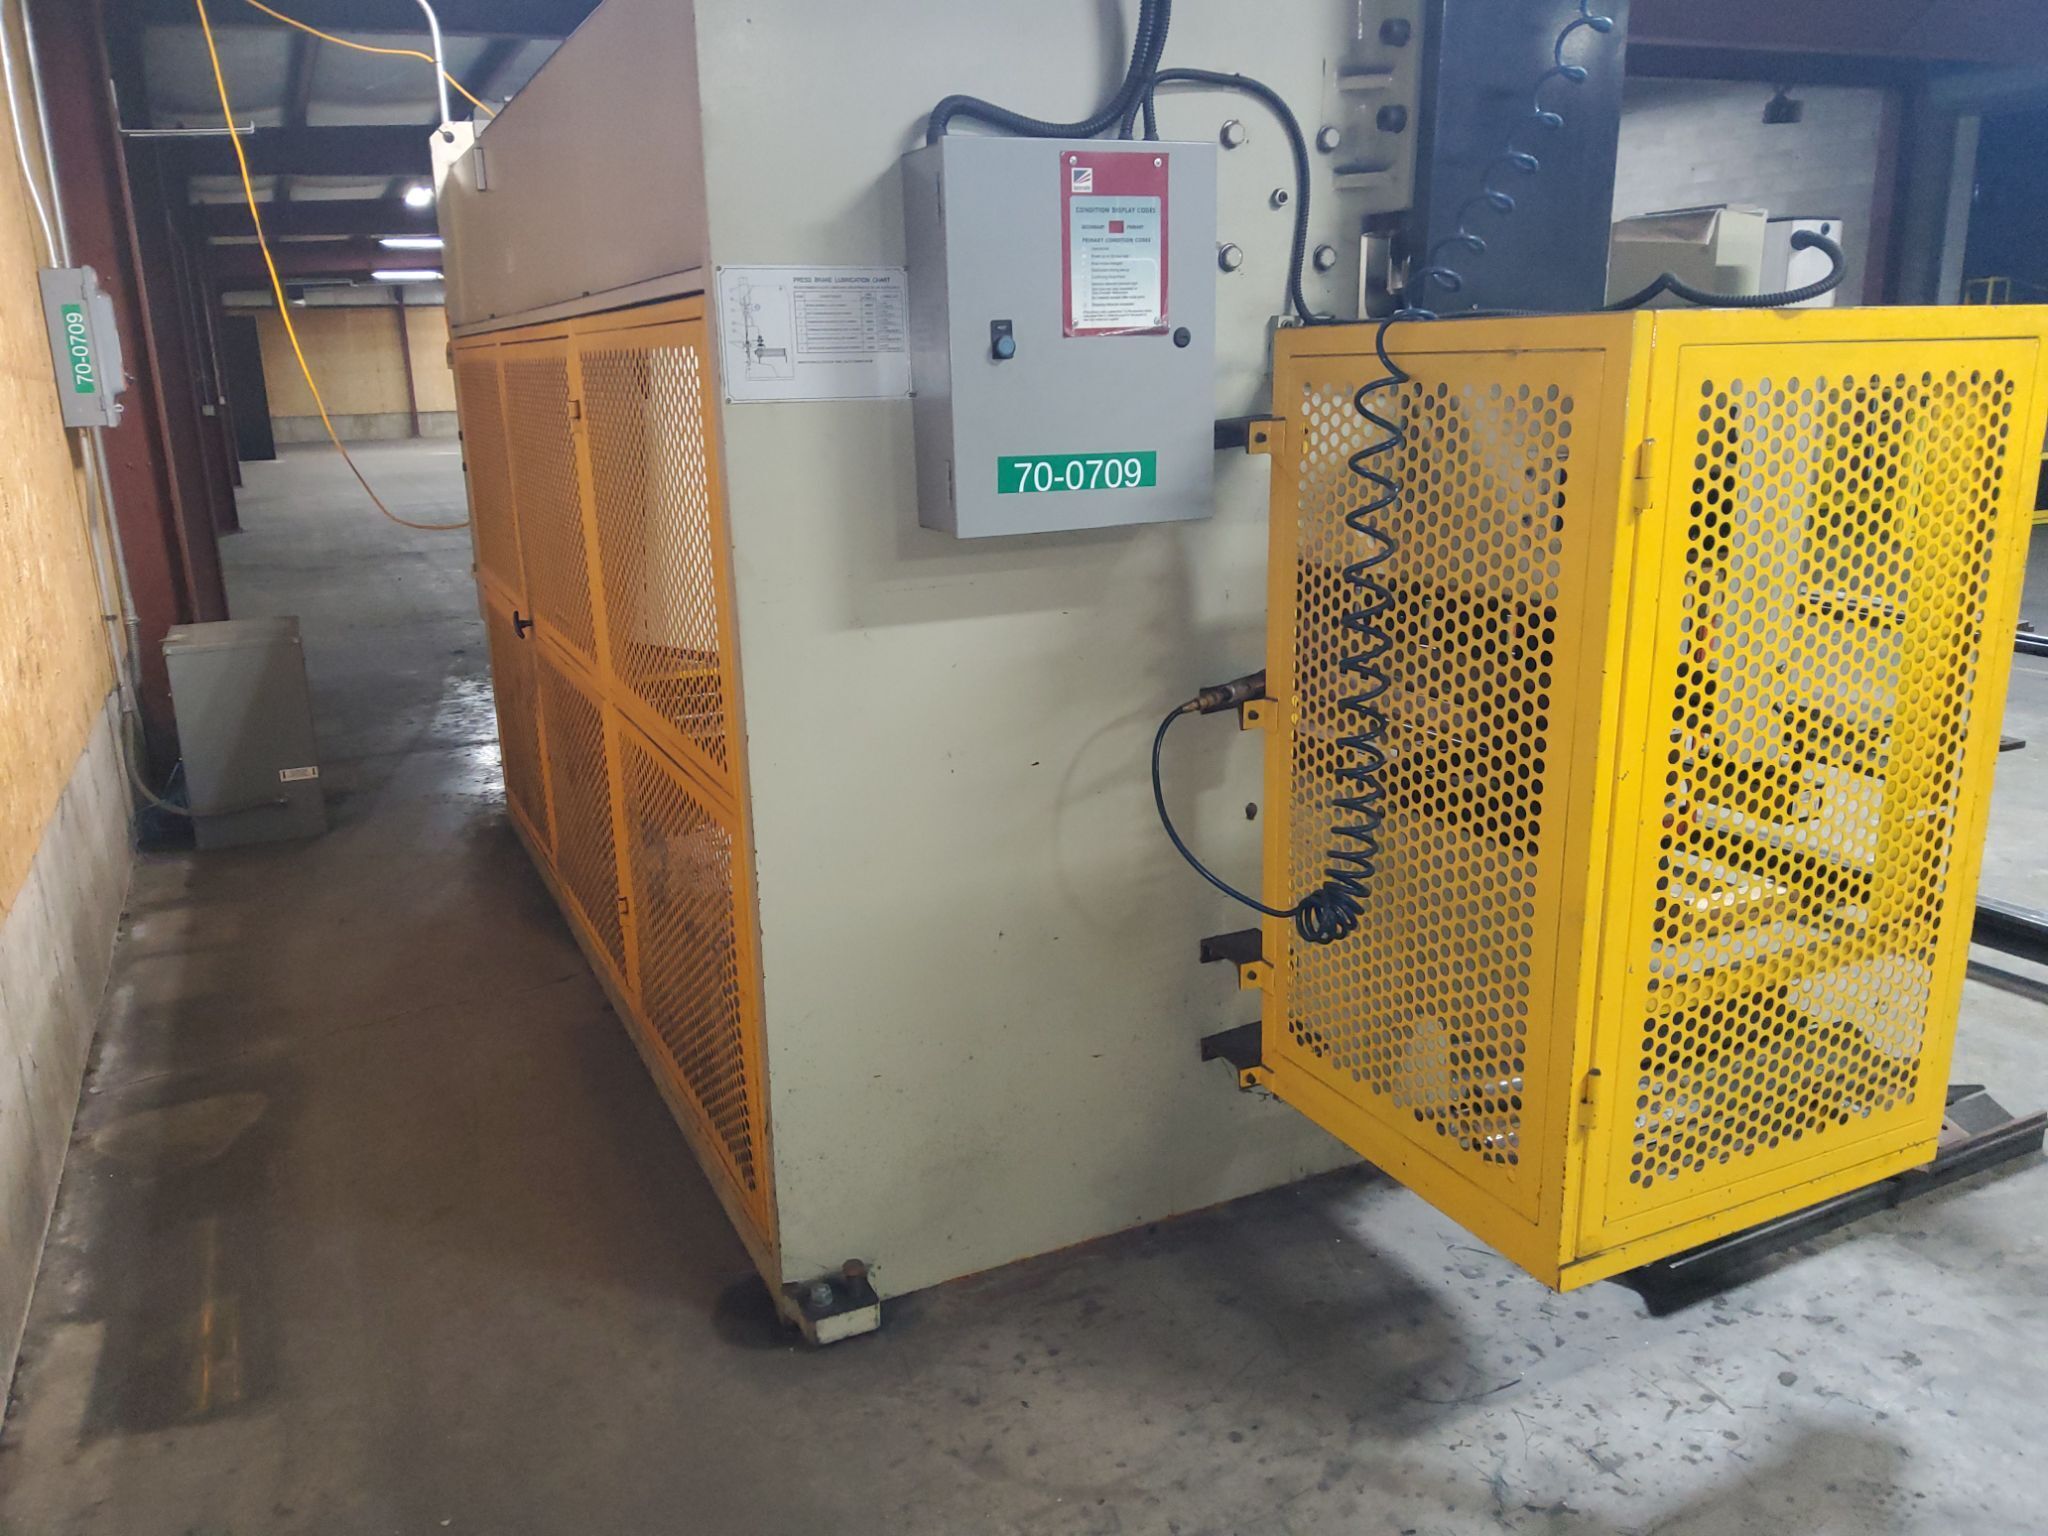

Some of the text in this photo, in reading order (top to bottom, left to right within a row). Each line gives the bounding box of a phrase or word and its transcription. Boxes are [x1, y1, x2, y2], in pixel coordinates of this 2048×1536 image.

[1075, 206, 1156, 214] CONDITION DISPLAY CODES
[65, 312, 95, 385] 70-0709
[1013, 457, 1142, 493] 70-0709
